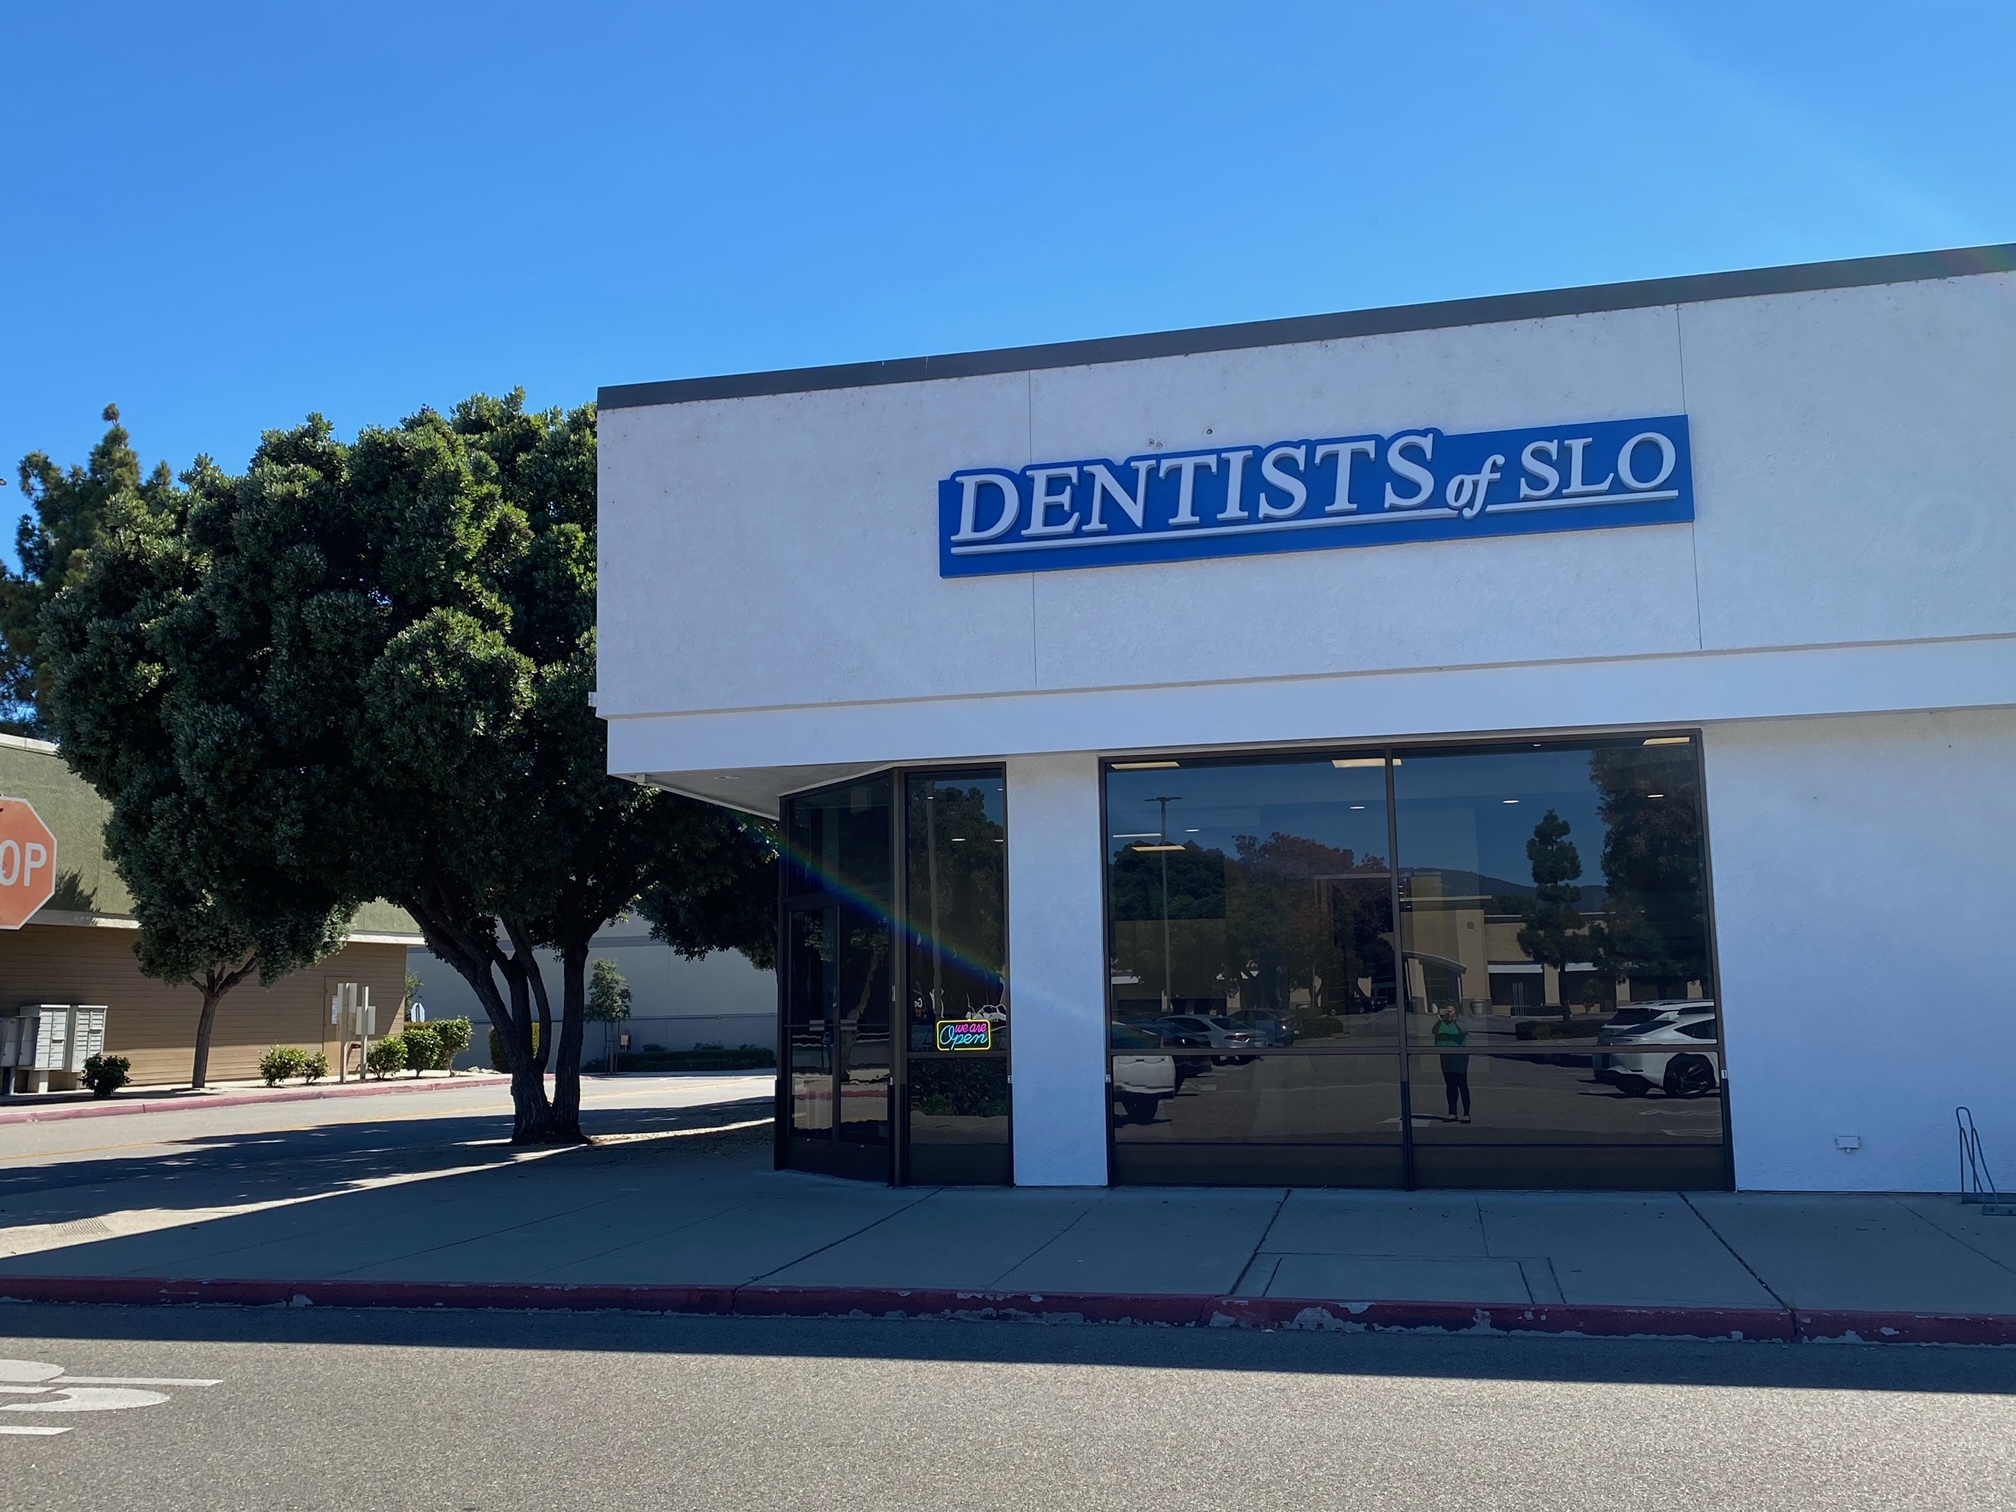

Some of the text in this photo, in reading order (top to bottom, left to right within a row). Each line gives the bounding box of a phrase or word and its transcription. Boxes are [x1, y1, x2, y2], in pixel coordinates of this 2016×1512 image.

[951, 432, 1677, 541] DENTISTS of SLO
[940, 1025, 988, 1050] Open
[955, 1023, 987, 1033] we are
